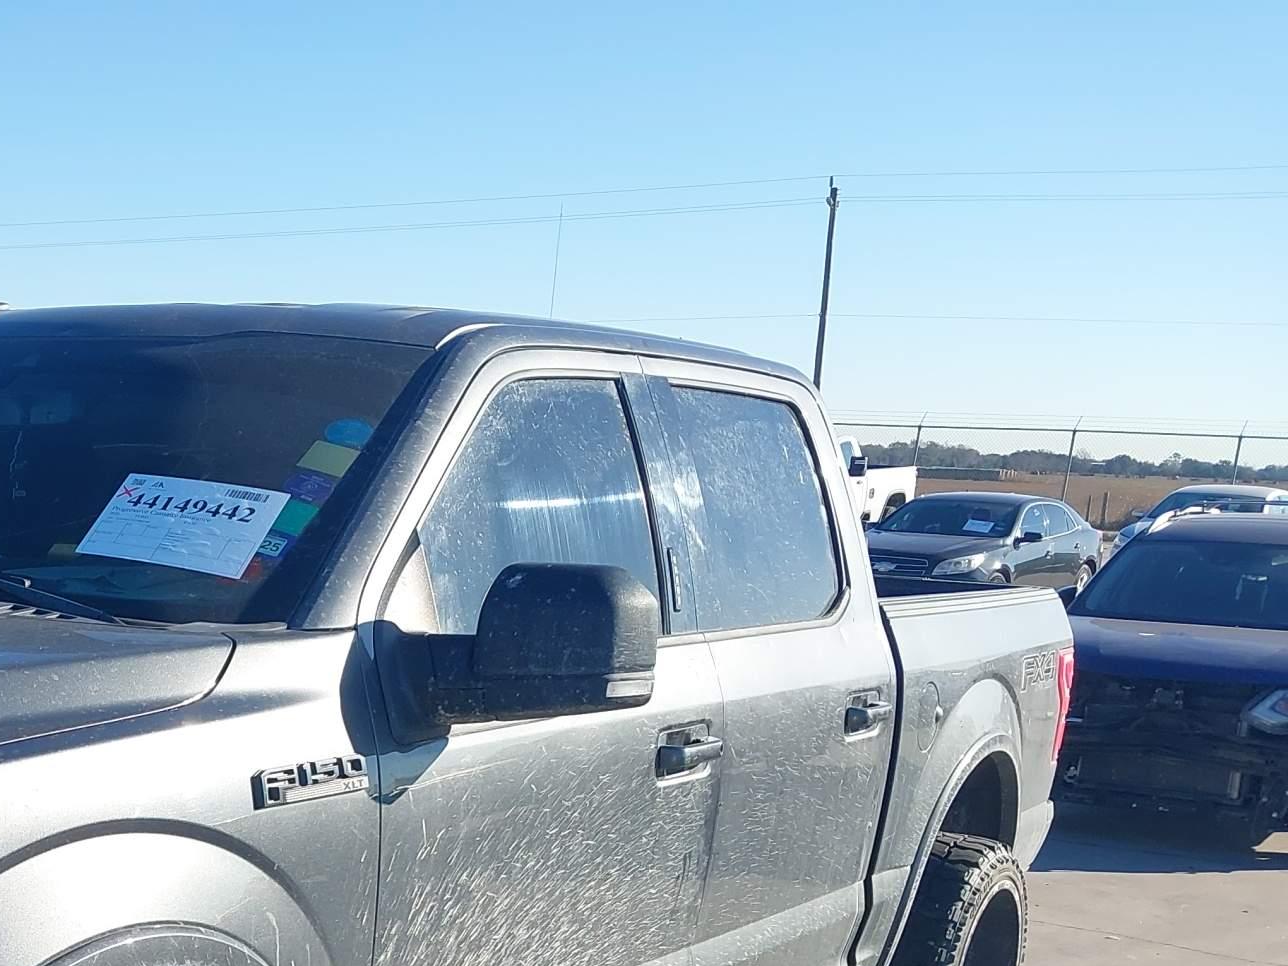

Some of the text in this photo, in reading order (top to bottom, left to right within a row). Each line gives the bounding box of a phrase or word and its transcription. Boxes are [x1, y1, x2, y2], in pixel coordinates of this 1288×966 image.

[127, 493, 256, 523] 44149442
[1020, 650, 1056, 693] FX4
[343, 779, 364, 791] XLT
